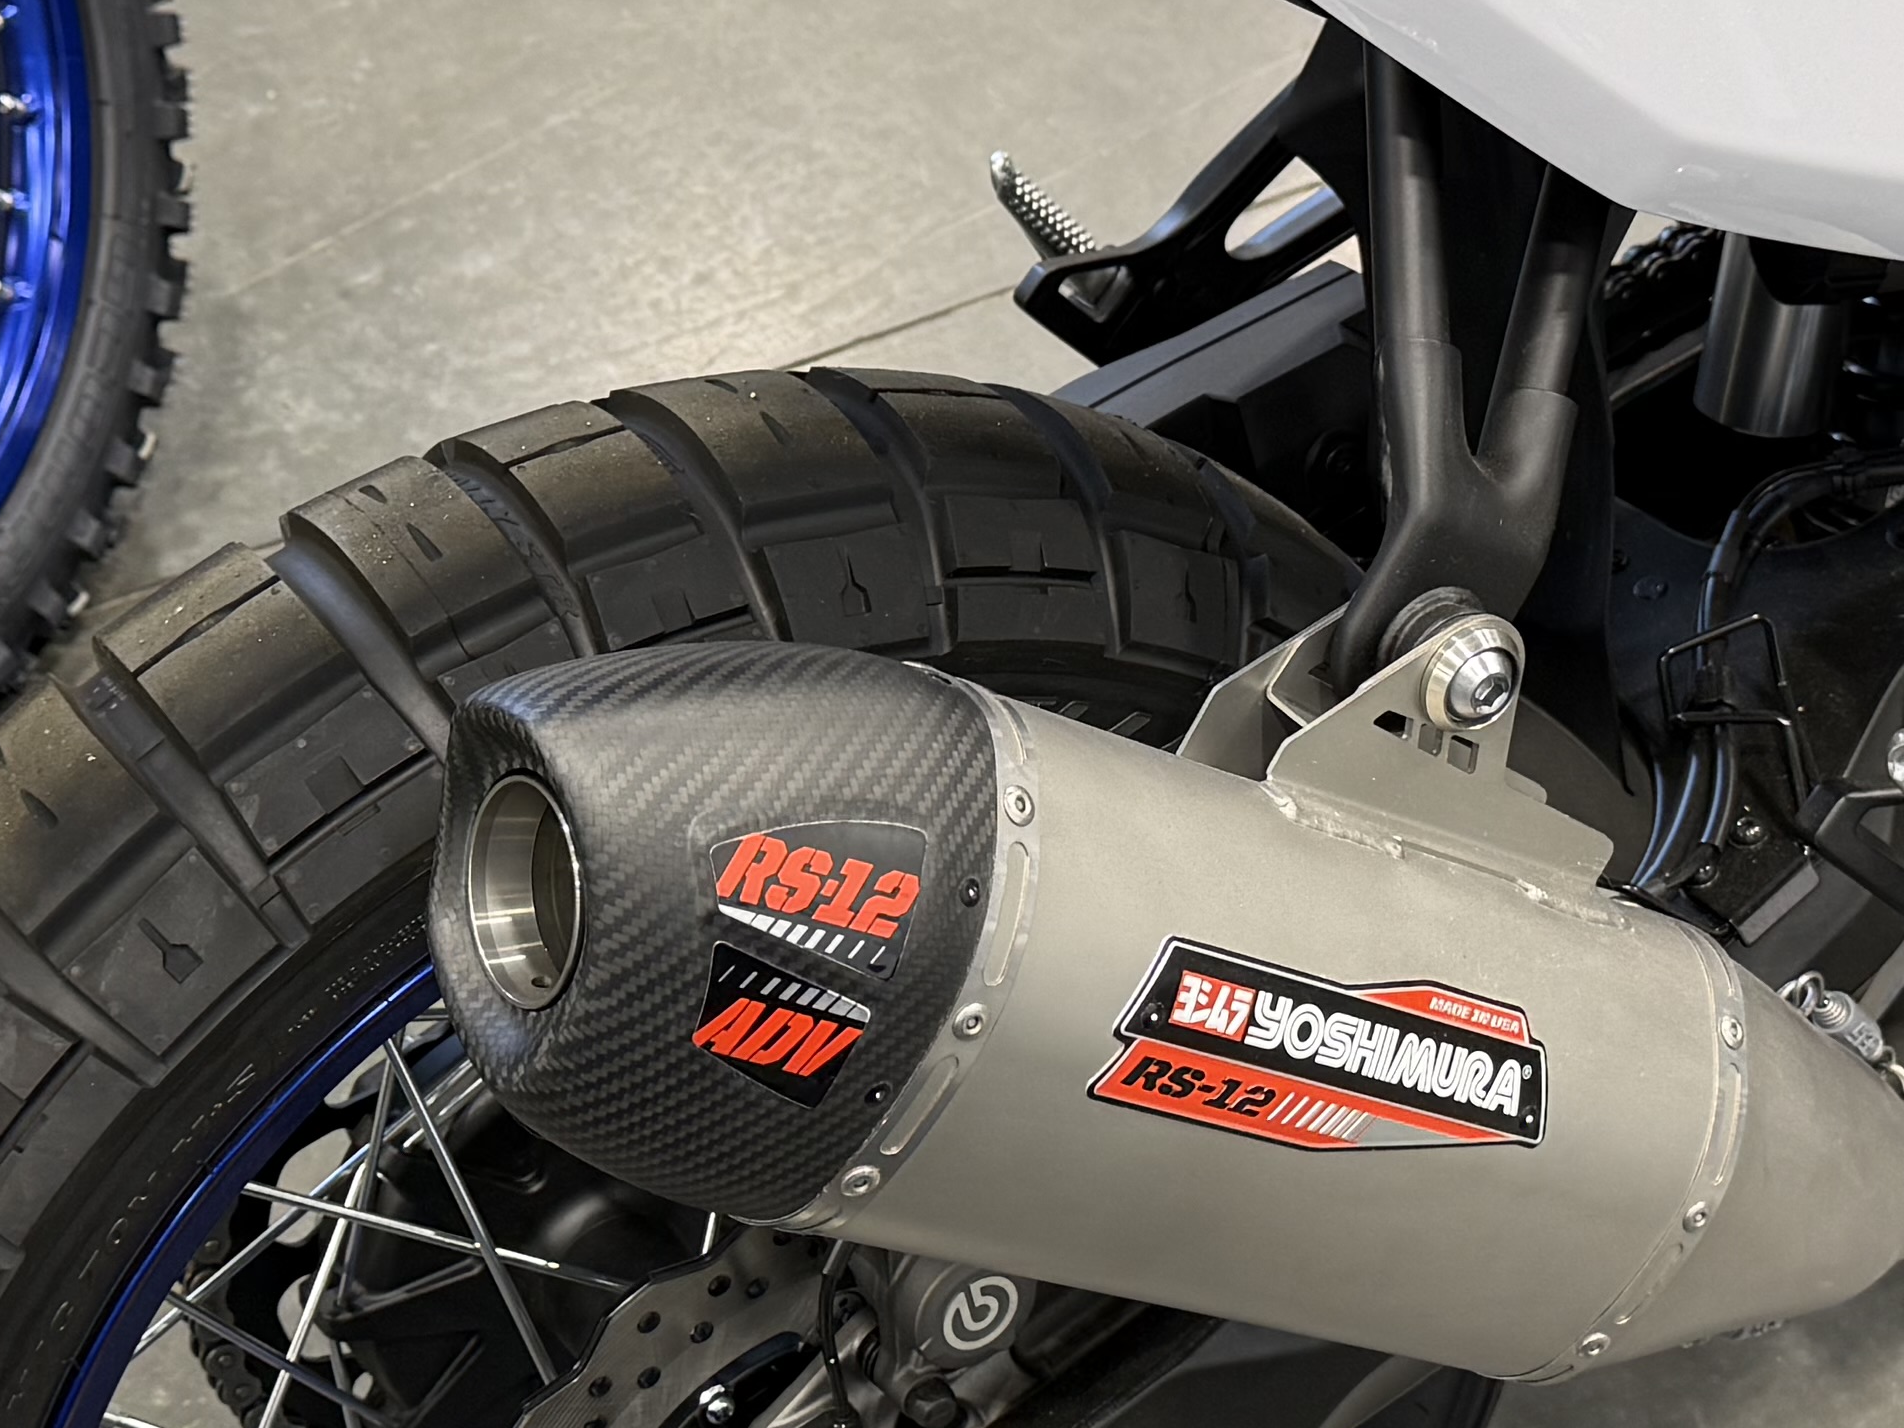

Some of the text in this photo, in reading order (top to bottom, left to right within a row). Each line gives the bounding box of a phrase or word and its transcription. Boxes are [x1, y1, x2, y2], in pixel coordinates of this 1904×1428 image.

[716, 832, 921, 939] RS-12
[692, 997, 864, 1077] ADV
[1244, 989, 1521, 1117] YOSHIMURA
[1429, 996, 1521, 1036] MADE IN USA
[1119, 1056, 1277, 1120] RS-12
